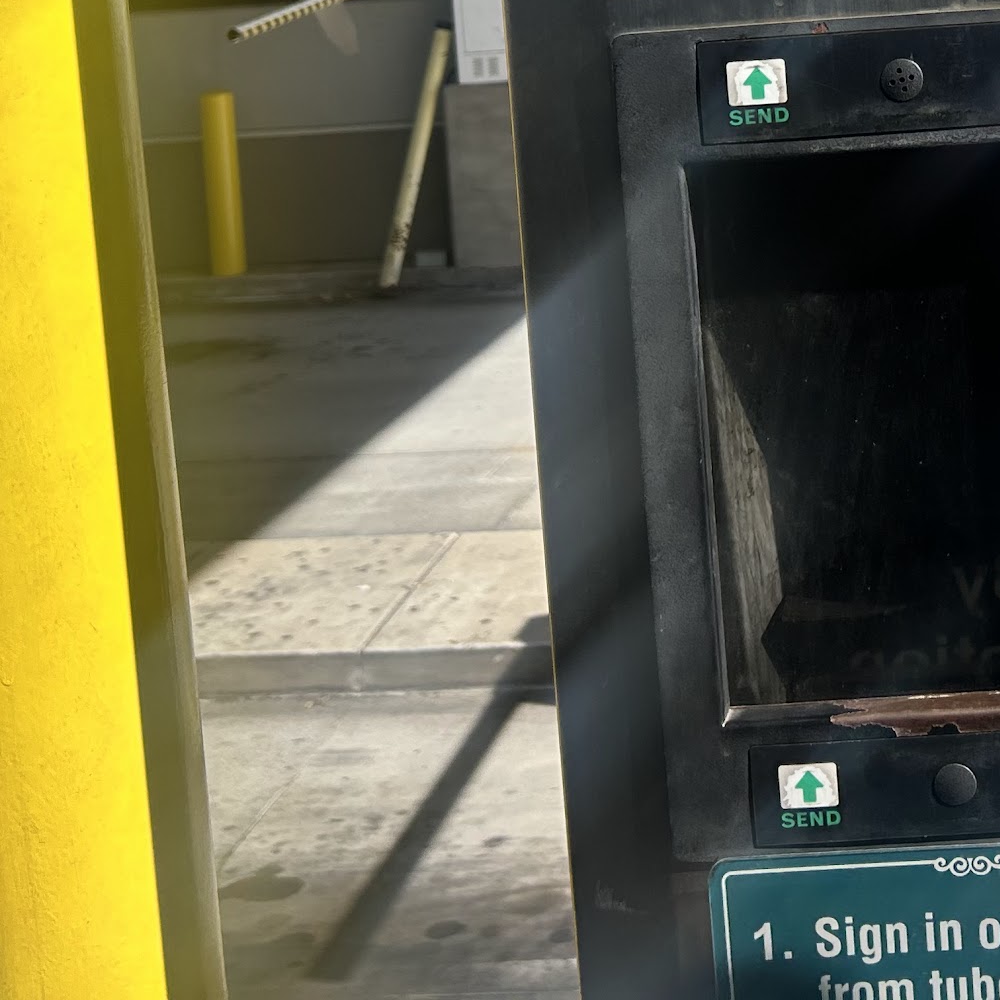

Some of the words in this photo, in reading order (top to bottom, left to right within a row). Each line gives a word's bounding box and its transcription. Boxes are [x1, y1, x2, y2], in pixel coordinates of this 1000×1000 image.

[728, 107, 790, 127] SEND
[781, 810, 841, 829] SEND
[753, 922, 793, 960] 1.
[815, 915, 909, 964] Sign
[925, 912, 962, 952] in
[818, 974, 915, 1000] from
